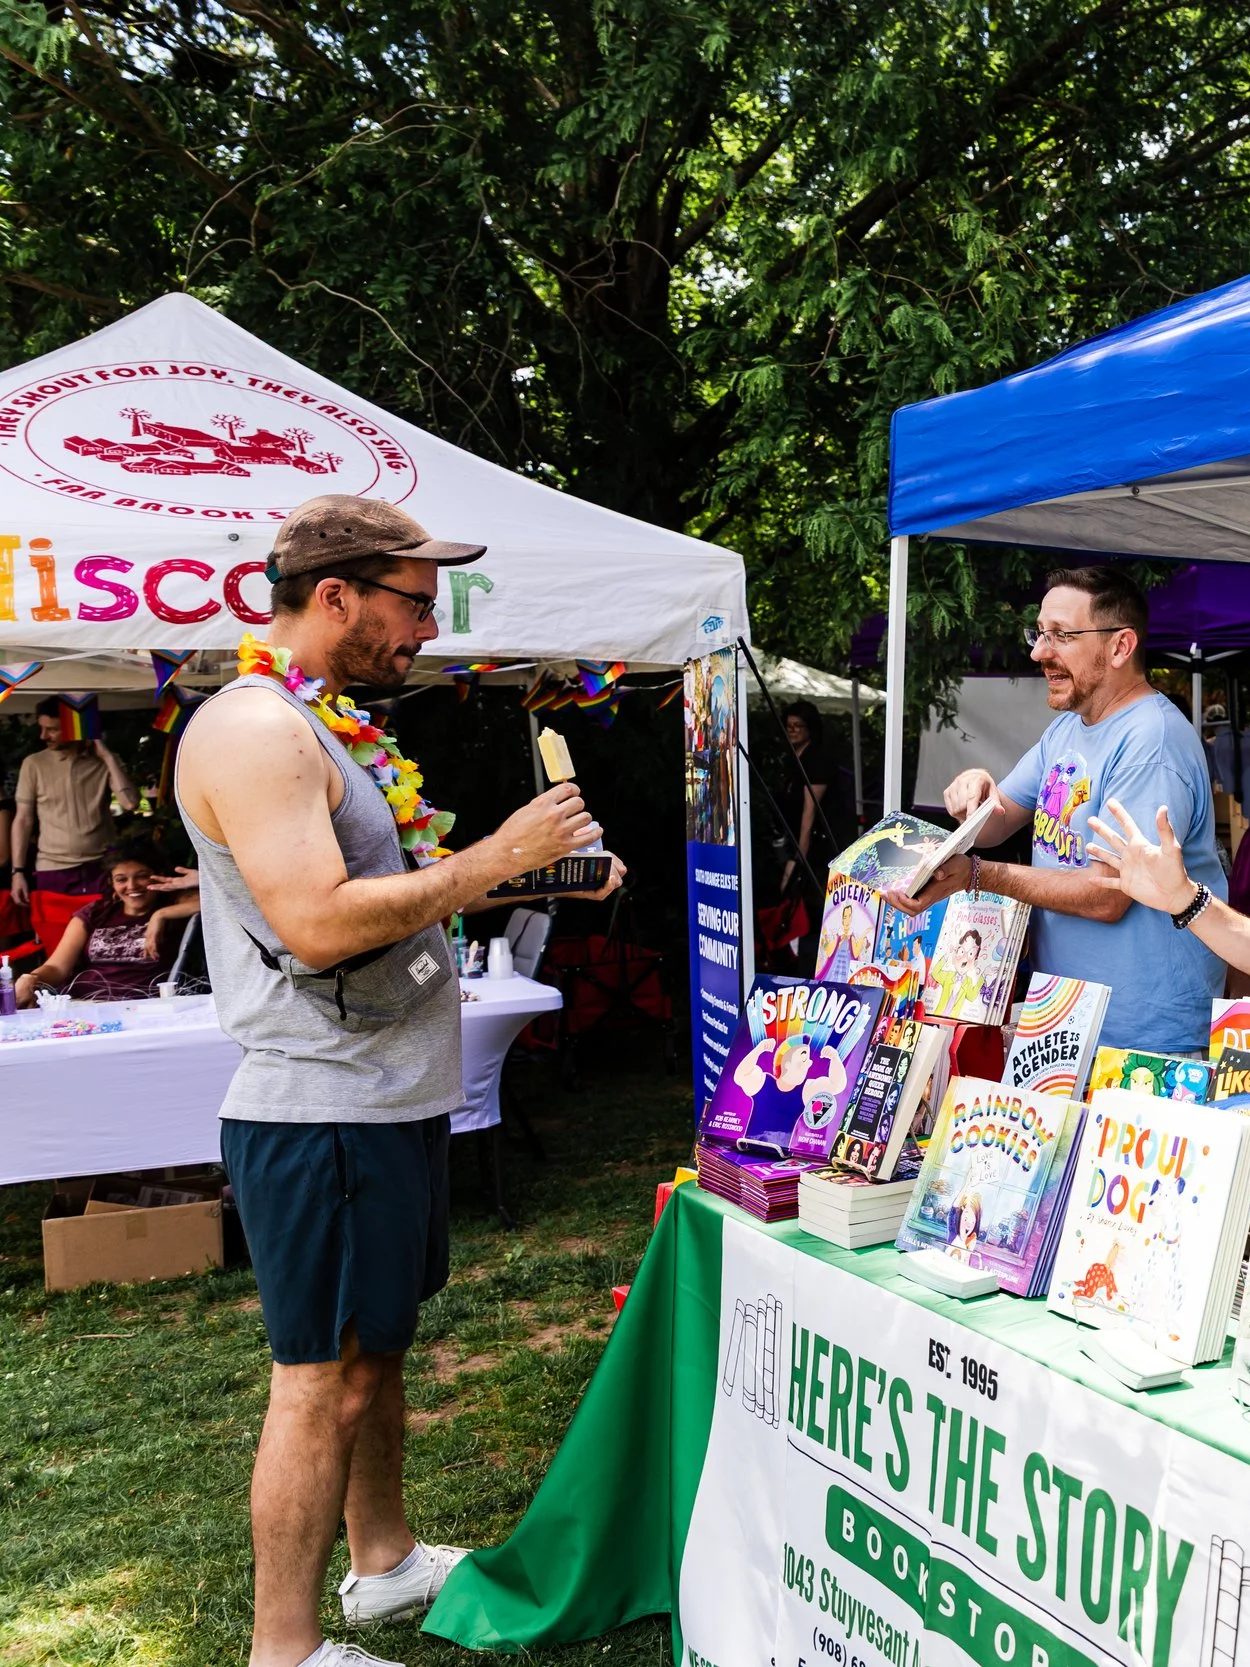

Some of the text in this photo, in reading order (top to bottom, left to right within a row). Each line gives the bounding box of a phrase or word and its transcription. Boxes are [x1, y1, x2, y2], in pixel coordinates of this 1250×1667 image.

[11, 373, 93, 408] SHOUT
[95, 365, 159, 381] FOR
[248, 377, 318, 403] THEY
[317, 405, 378, 436] ALSO
[41, 478, 252, 520] FAR BROOK
[833, 885, 870, 907] QUEEN?
[972, 911, 998, 926] Glasses
[697, 902, 739, 937] SERVING OUR
[898, 910, 932, 940] HOME
[699, 933, 738, 970] COMMUNITY
[763, 985, 861, 1034] STRONG
[1012, 1030, 1080, 1071] ATHLETE IS
[1013, 1044, 1080, 1088] AGENDER
[953, 1093, 1056, 1148] RAINBOW
[950, 1123, 1038, 1173] COOKIES
[1097, 1117, 1197, 1180] PROUD
[1086, 1167, 1152, 1224] DOG
[928, 1337, 999, 1402] EST. 1995
[787, 1320, 1196, 1667] HERE'S THE STORY
[783, 1541, 815, 1604] 1043
[818, 1567, 910, 1665] Stuyvesant
[813, 1626, 848, 1667] (908)
